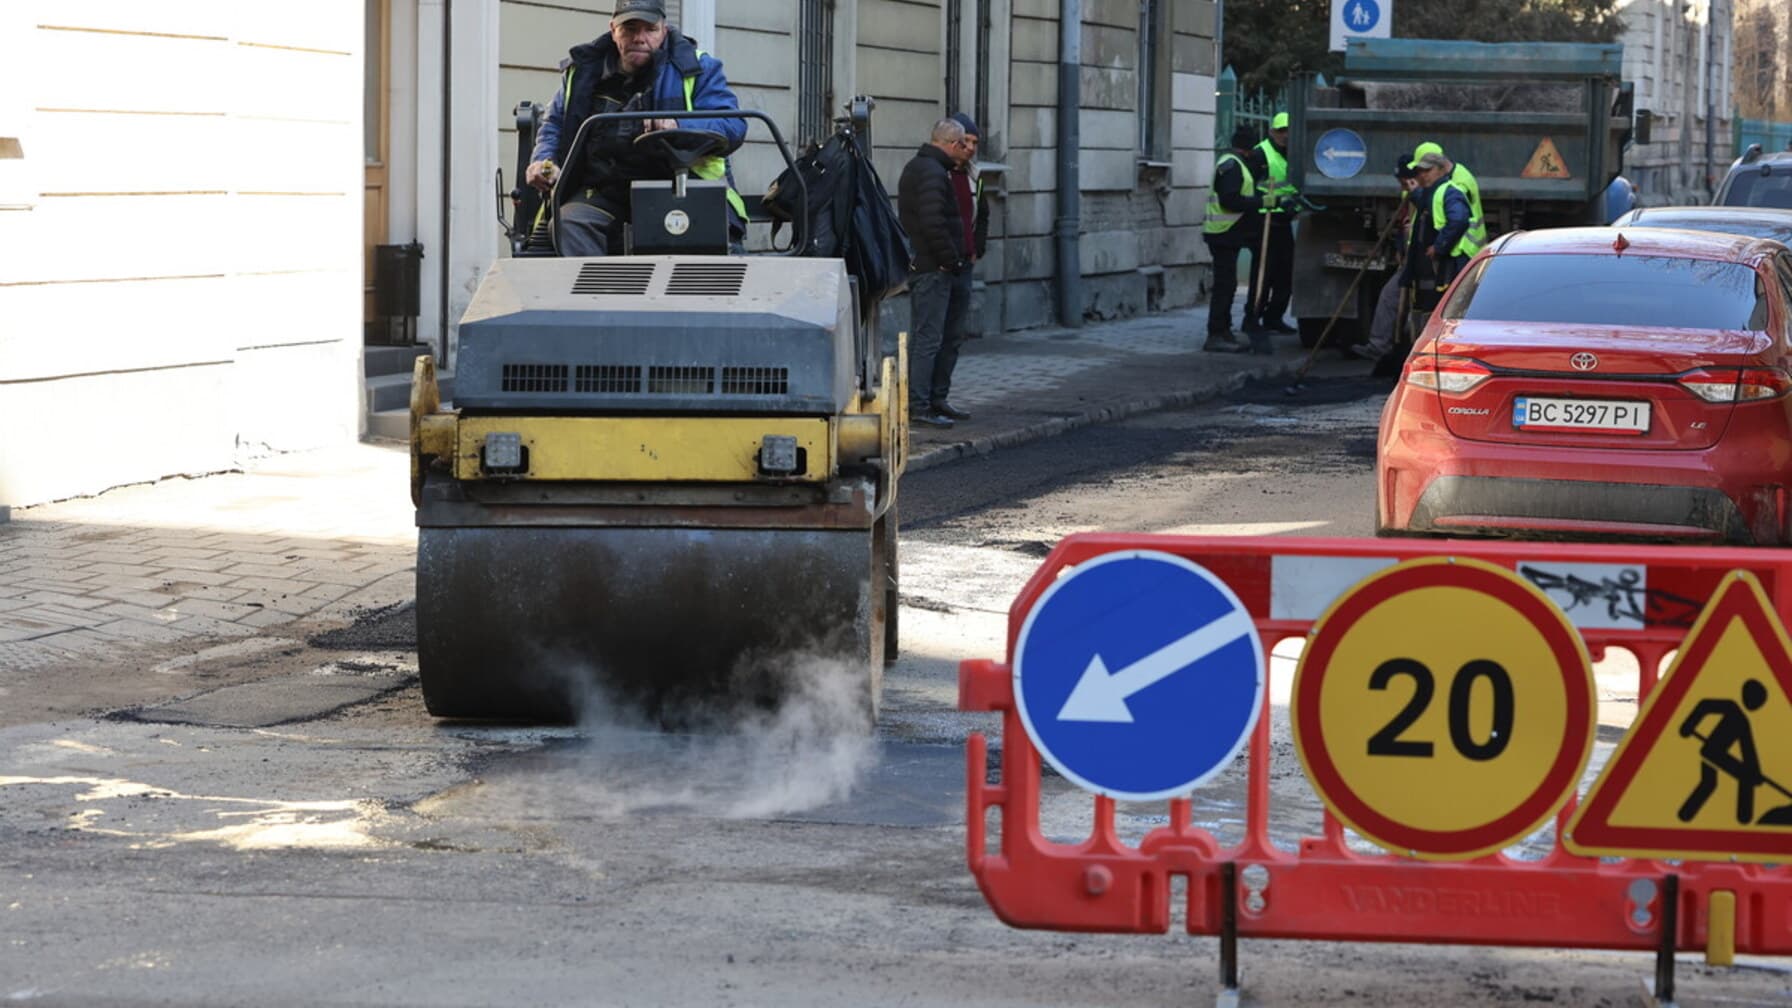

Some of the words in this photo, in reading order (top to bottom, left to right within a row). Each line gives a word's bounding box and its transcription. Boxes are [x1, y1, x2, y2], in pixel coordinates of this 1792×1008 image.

[1448, 407, 1489, 415] COROLLA
[1529, 403, 1557, 422] BC
[1563, 404, 1608, 424] 5297
[1367, 657, 1515, 761] 20
[1342, 884, 1560, 919] VANDERLINE
